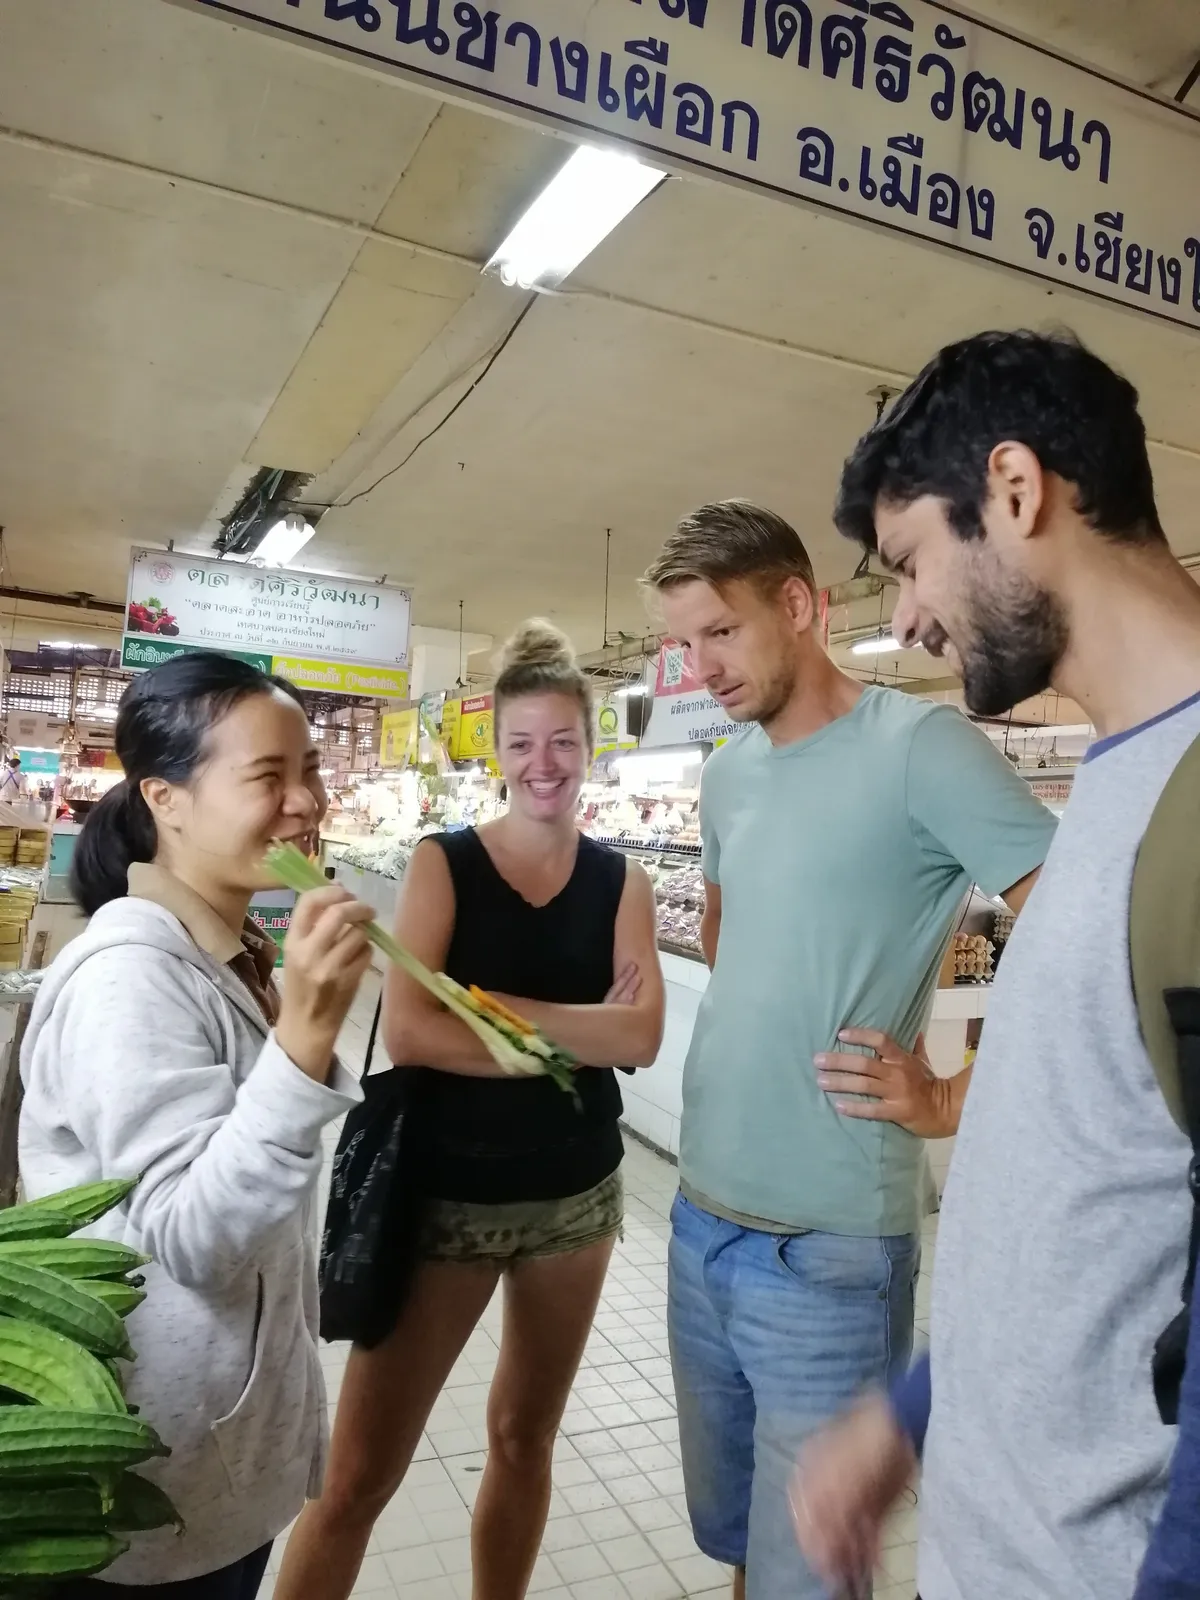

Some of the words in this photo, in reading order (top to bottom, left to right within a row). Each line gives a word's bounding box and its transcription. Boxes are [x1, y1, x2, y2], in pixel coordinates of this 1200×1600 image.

[796, 132, 995, 240] อ.เมือง
[670, 697, 723, 716] ผลิตจากฟาร์ม
